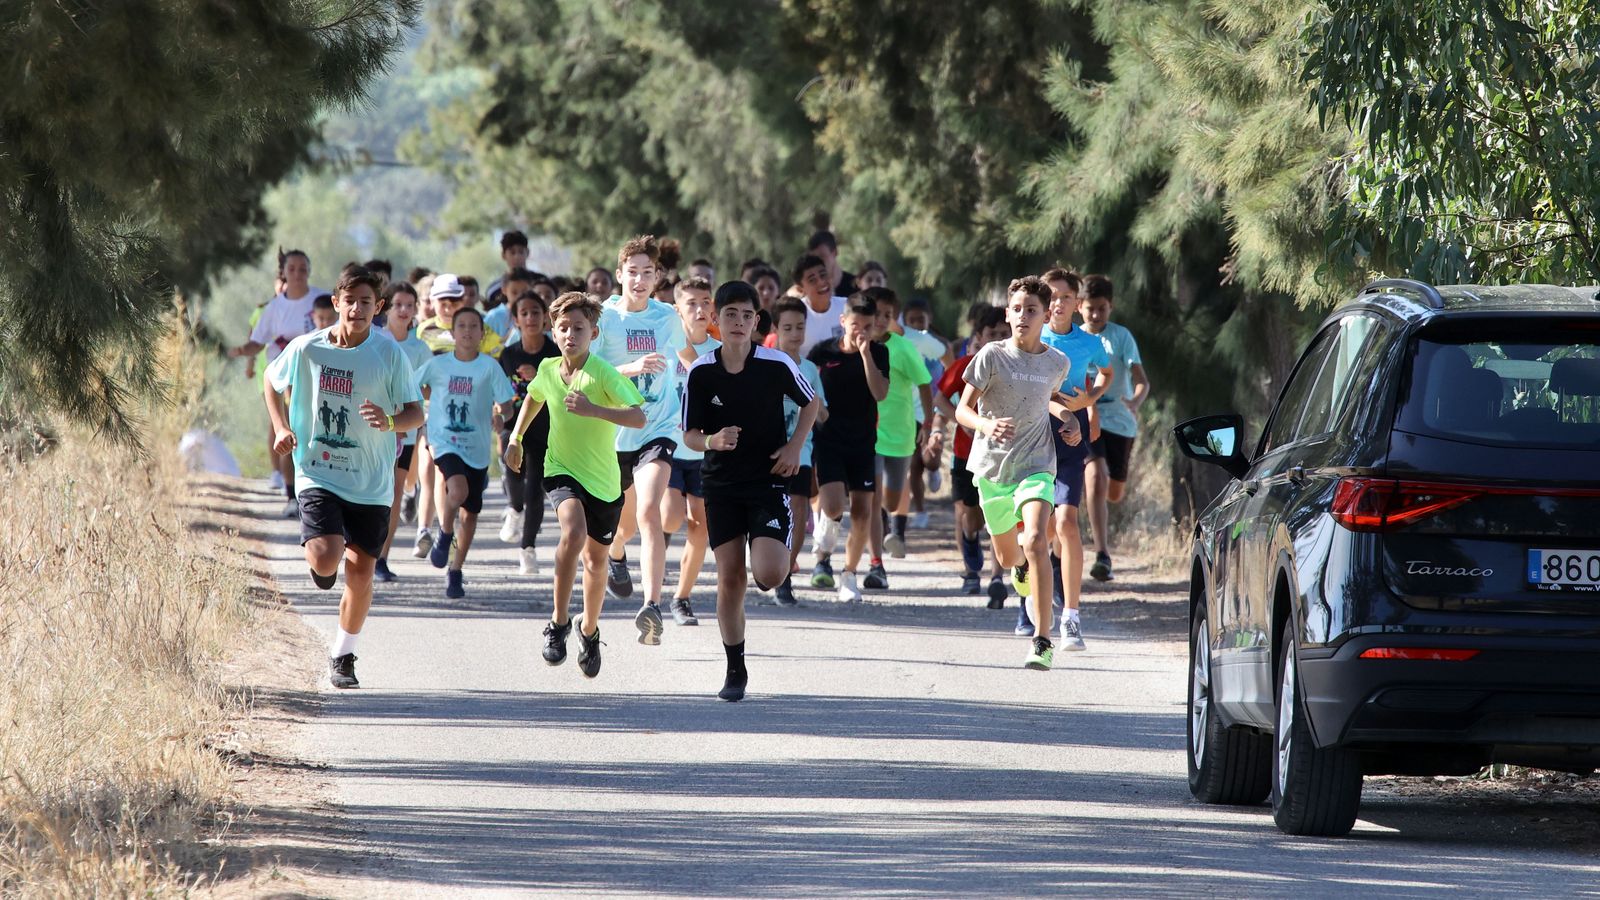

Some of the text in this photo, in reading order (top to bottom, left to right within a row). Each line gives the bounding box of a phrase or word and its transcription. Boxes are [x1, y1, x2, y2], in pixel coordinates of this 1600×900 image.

[627, 336, 657, 351] BARRO
[320, 374, 353, 394] BARRO
[1019, 373, 1029, 381] THE
[1029, 374, 1048, 384] CHANGE
[1406, 560, 1493, 577] Tarraco
[1531, 571, 1538, 579] E
[1547, 554, 1600, 582] 860
